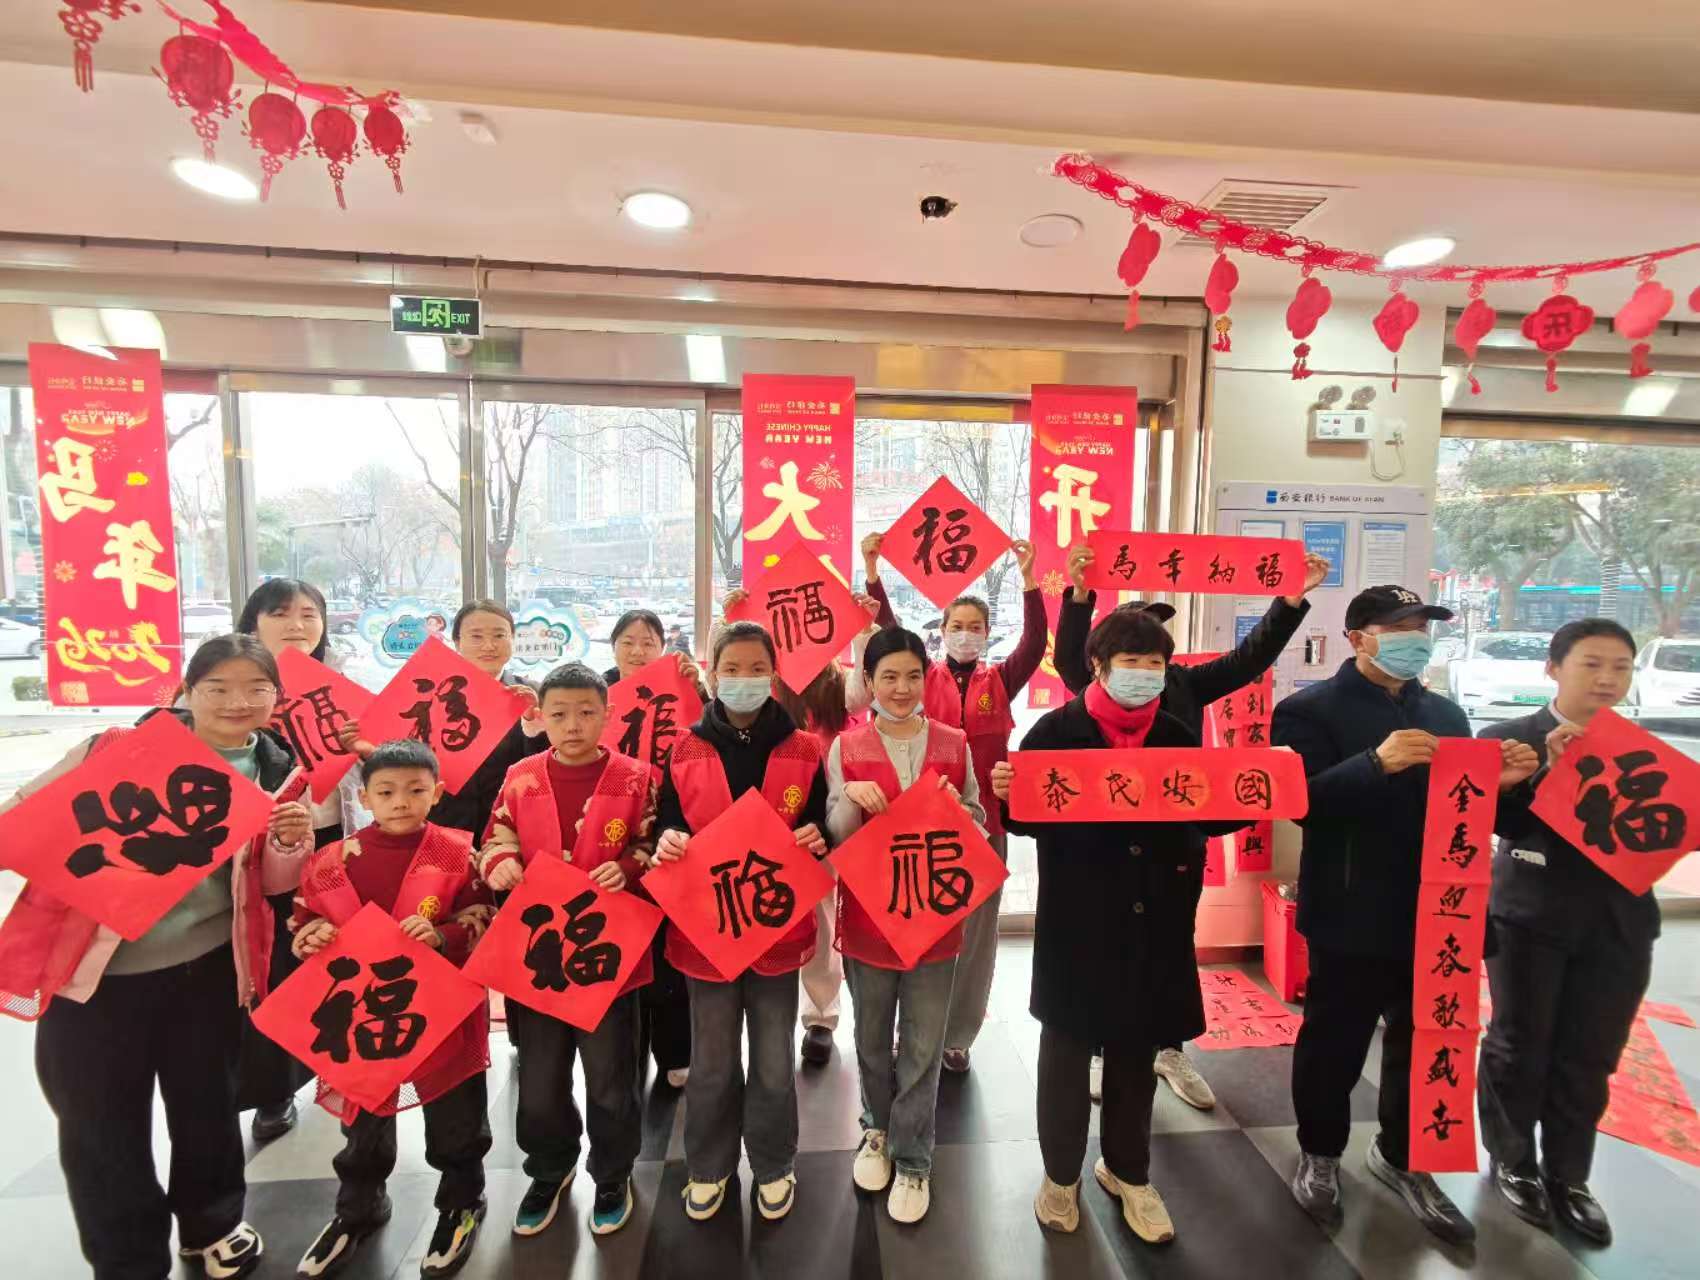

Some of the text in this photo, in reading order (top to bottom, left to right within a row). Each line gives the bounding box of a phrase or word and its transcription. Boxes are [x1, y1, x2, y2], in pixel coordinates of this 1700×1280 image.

[451, 313, 471, 325] EXIT
[1279, 491, 1326, 504] 西安银行
[1329, 495, 1351, 503] BANK
[911, 506, 978, 577] 福
[766, 581, 835, 653] 福
[399, 675, 481, 752] 福
[617, 684, 679, 770] 福
[1574, 749, 1688, 856] 福
[710, 848, 796, 939] 福
[886, 829, 975, 920] 福
[520, 889, 622, 993] 福
[310, 954, 427, 1064] 福
